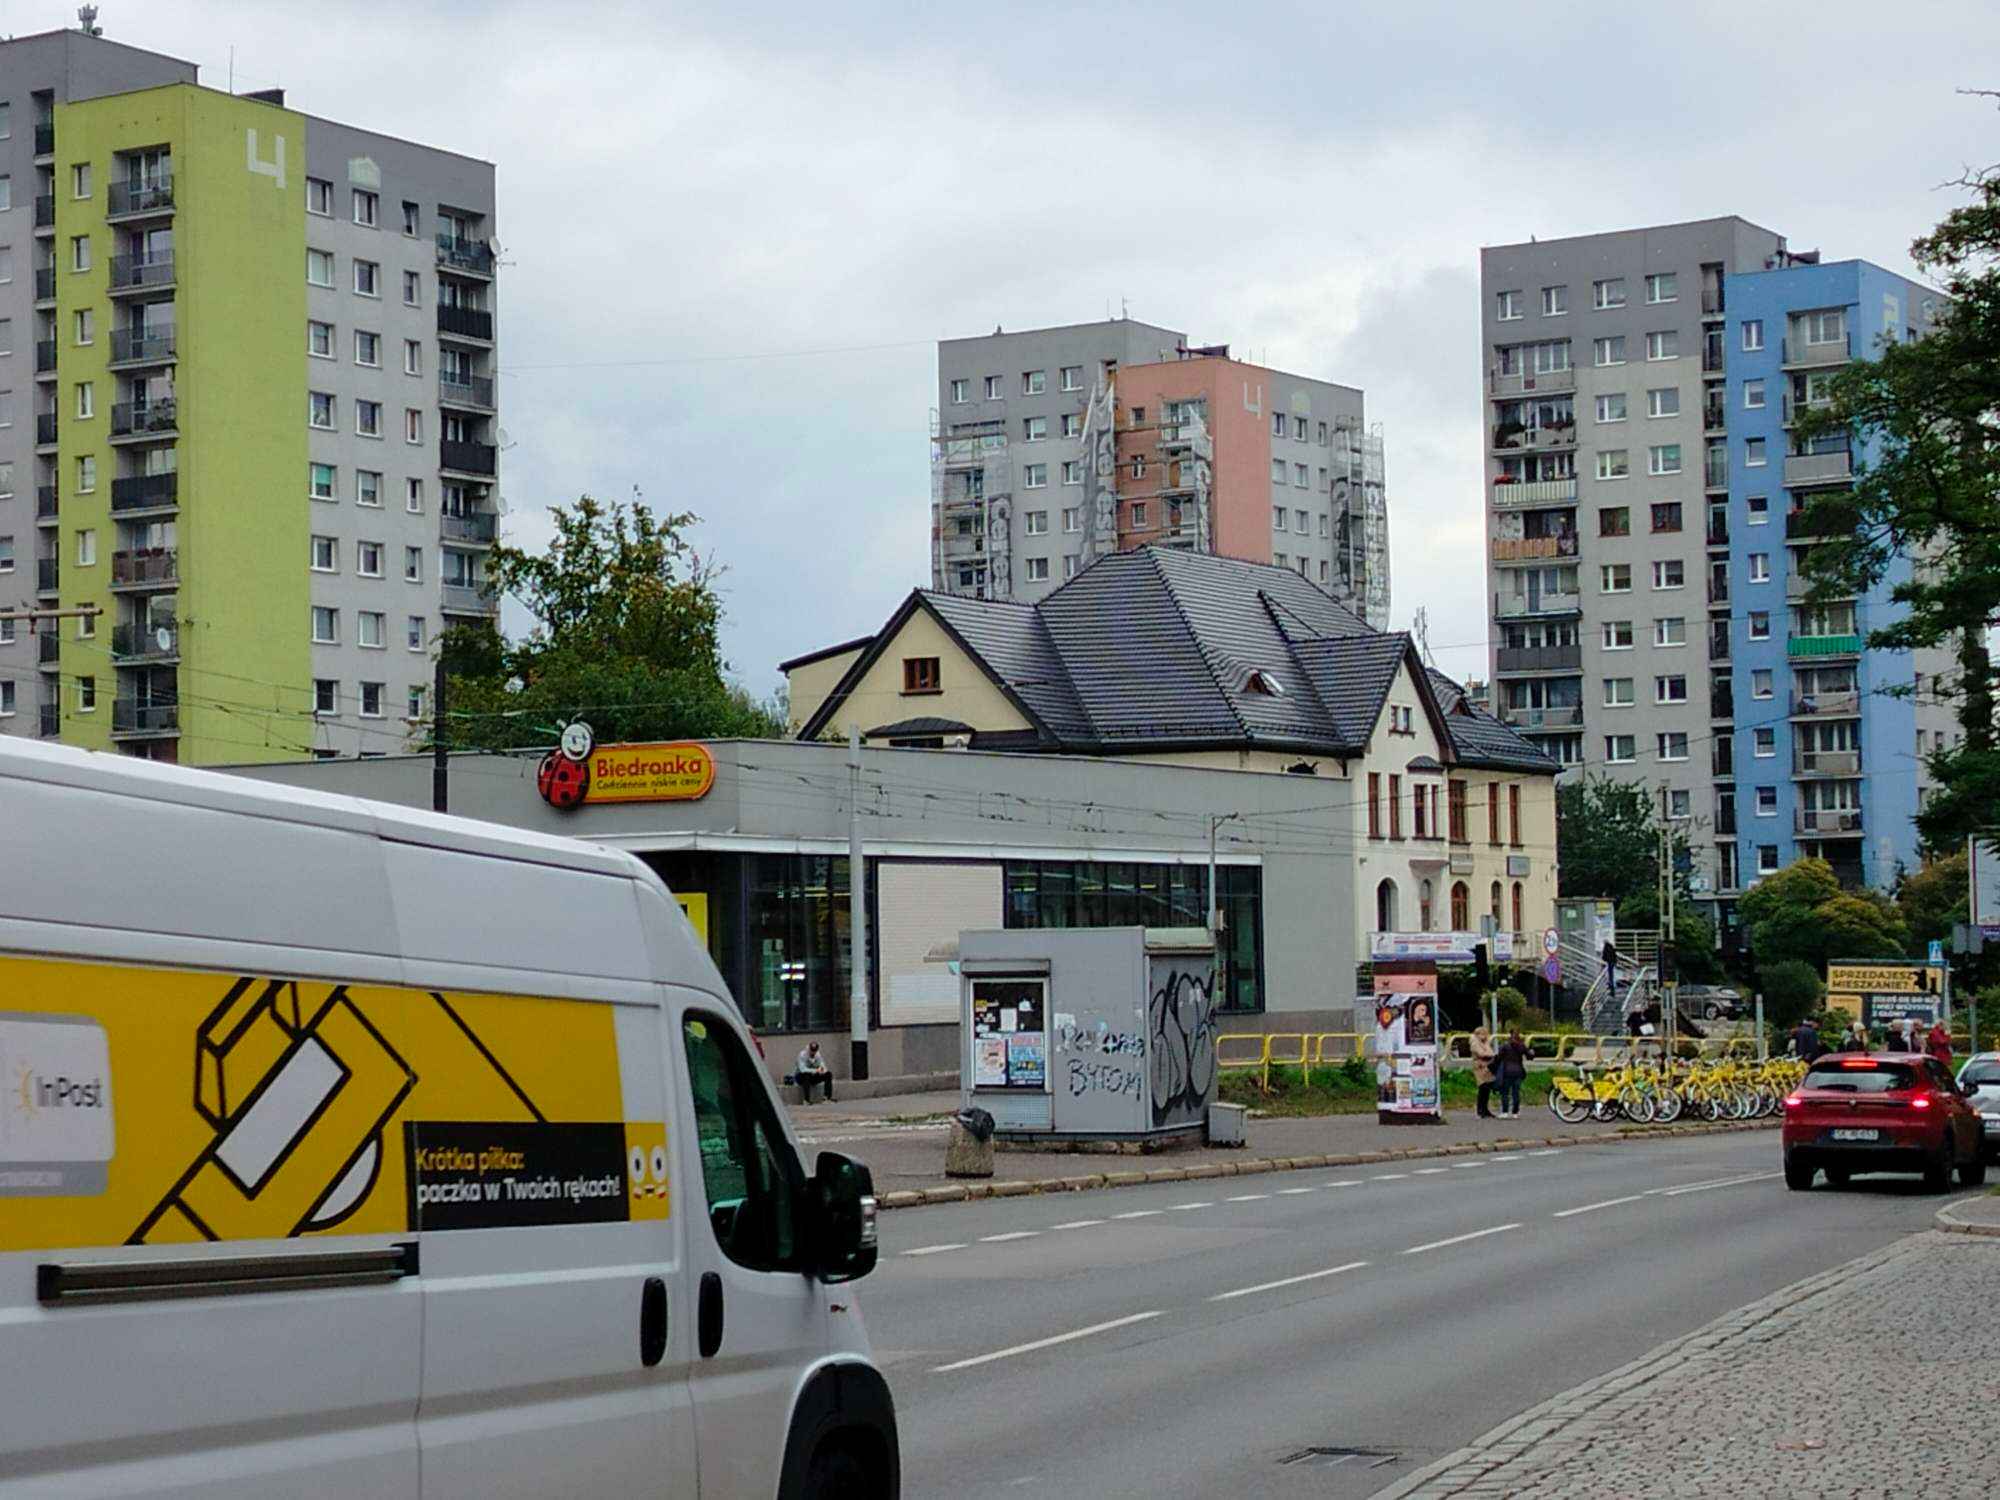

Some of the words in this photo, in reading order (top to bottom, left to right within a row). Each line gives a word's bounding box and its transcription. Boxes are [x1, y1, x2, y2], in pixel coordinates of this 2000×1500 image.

[246, 128, 287, 189] 4
[1243, 381, 1262, 420] 4
[596, 754, 702, 778] Biedronka
[1832, 969, 1915, 980] SPRZEDAJESZ
[1832, 979, 1909, 990] MIESZKANIE?
[35, 1076, 103, 1108] InPost
[415, 1146, 476, 1171] Krótka
[478, 1146, 526, 1176] piłka:
[416, 1177, 482, 1210] paczka
[484, 1183, 501, 1201] w
[503, 1174, 562, 1201] Twoich
[563, 1174, 621, 1204] rękach!
